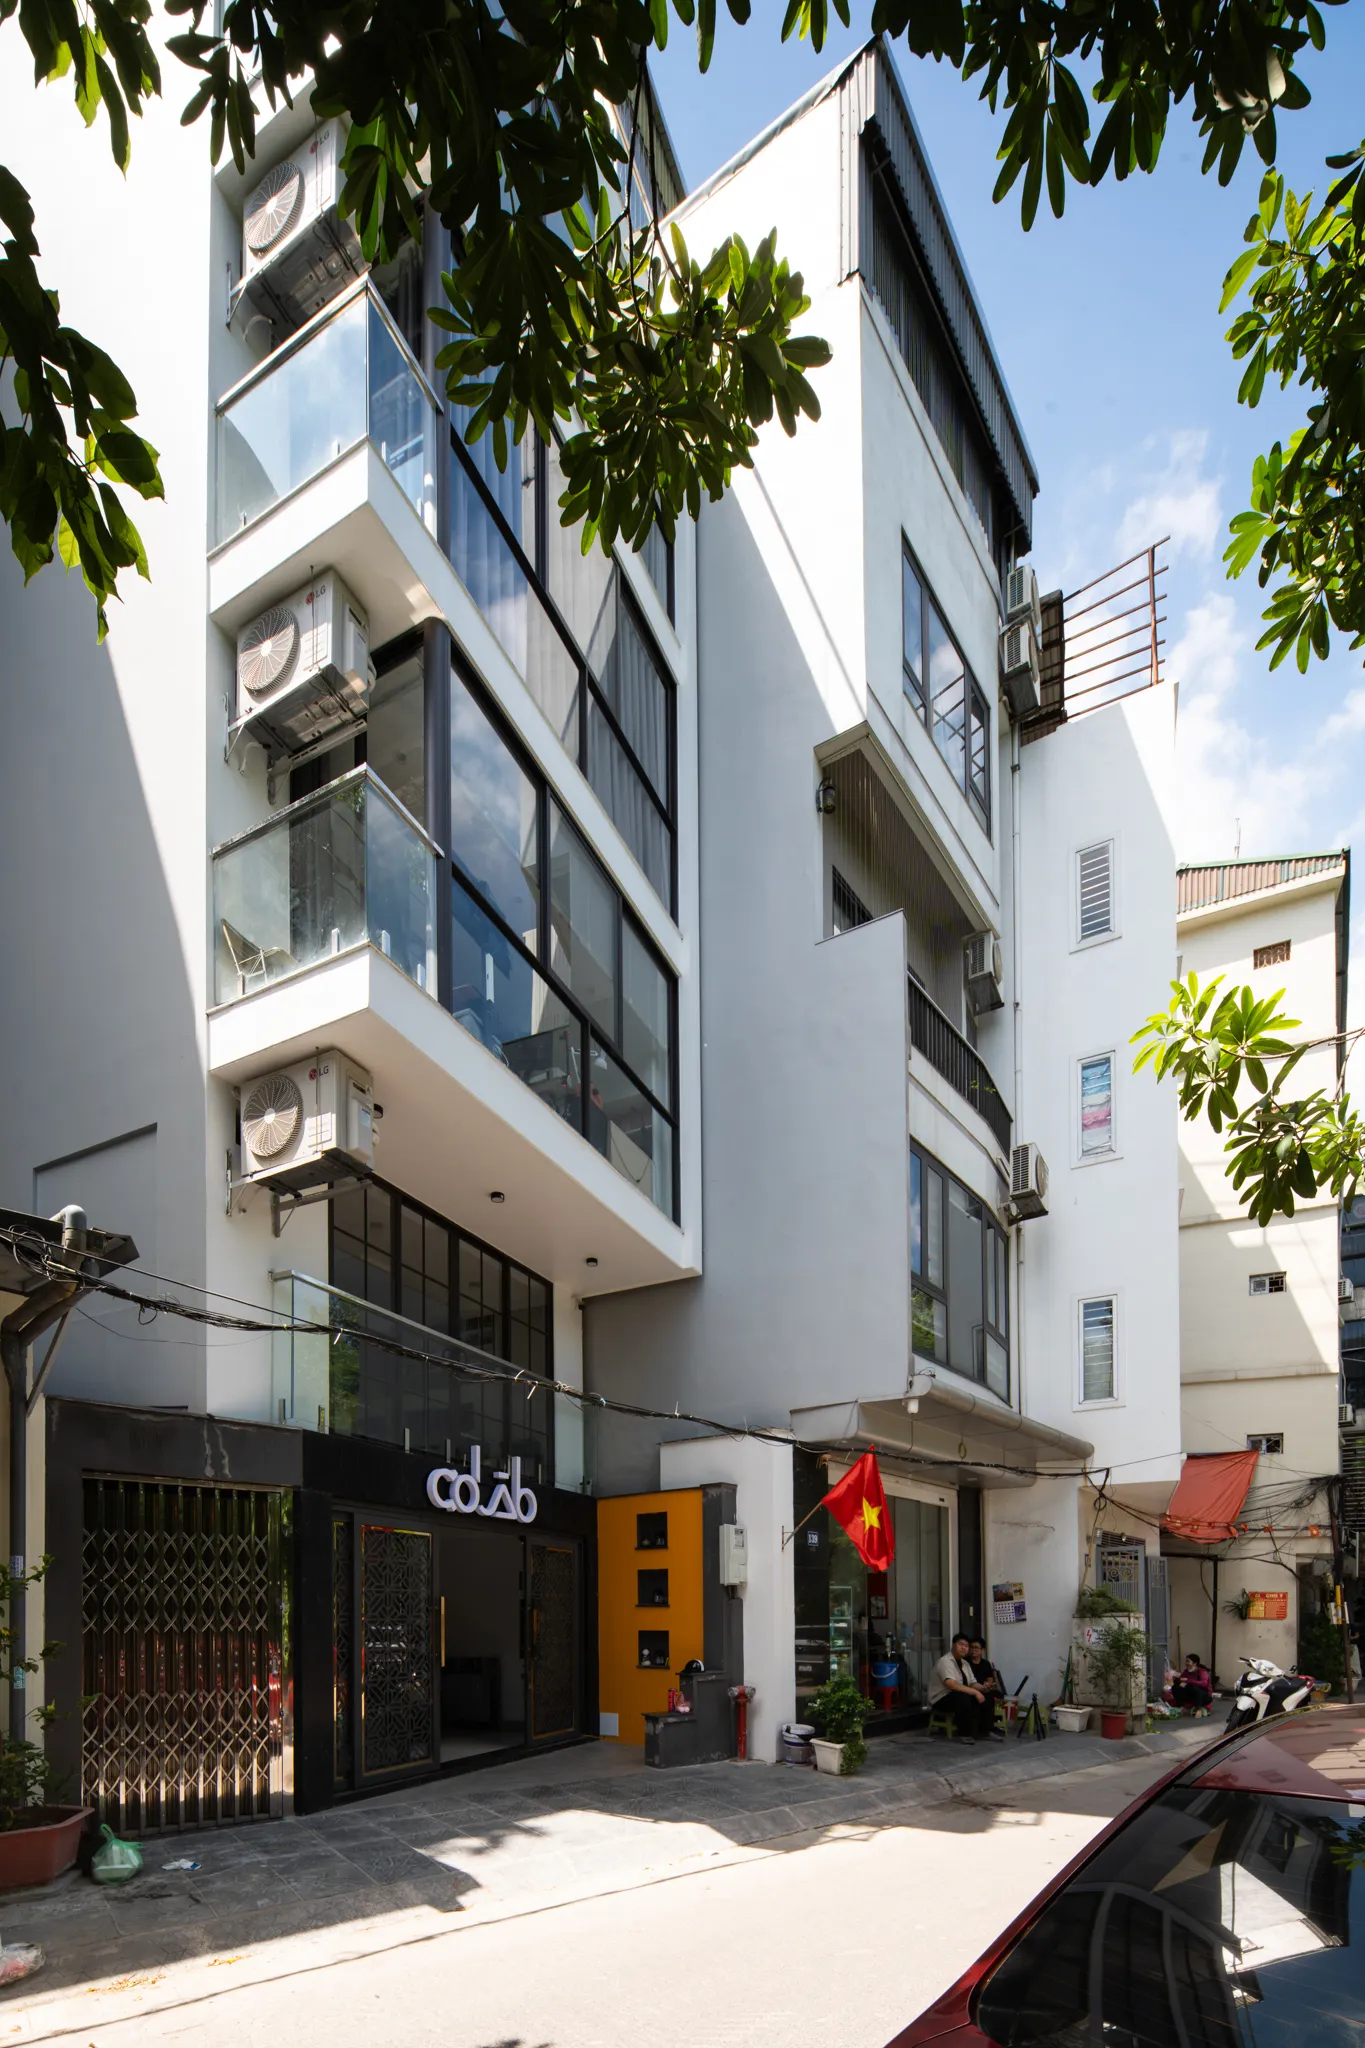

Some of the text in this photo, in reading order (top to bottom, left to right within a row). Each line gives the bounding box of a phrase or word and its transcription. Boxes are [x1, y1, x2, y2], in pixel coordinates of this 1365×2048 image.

[319, 129, 330, 146] LG
[315, 585, 326, 599] LG
[318, 1065, 329, 1077] LG
